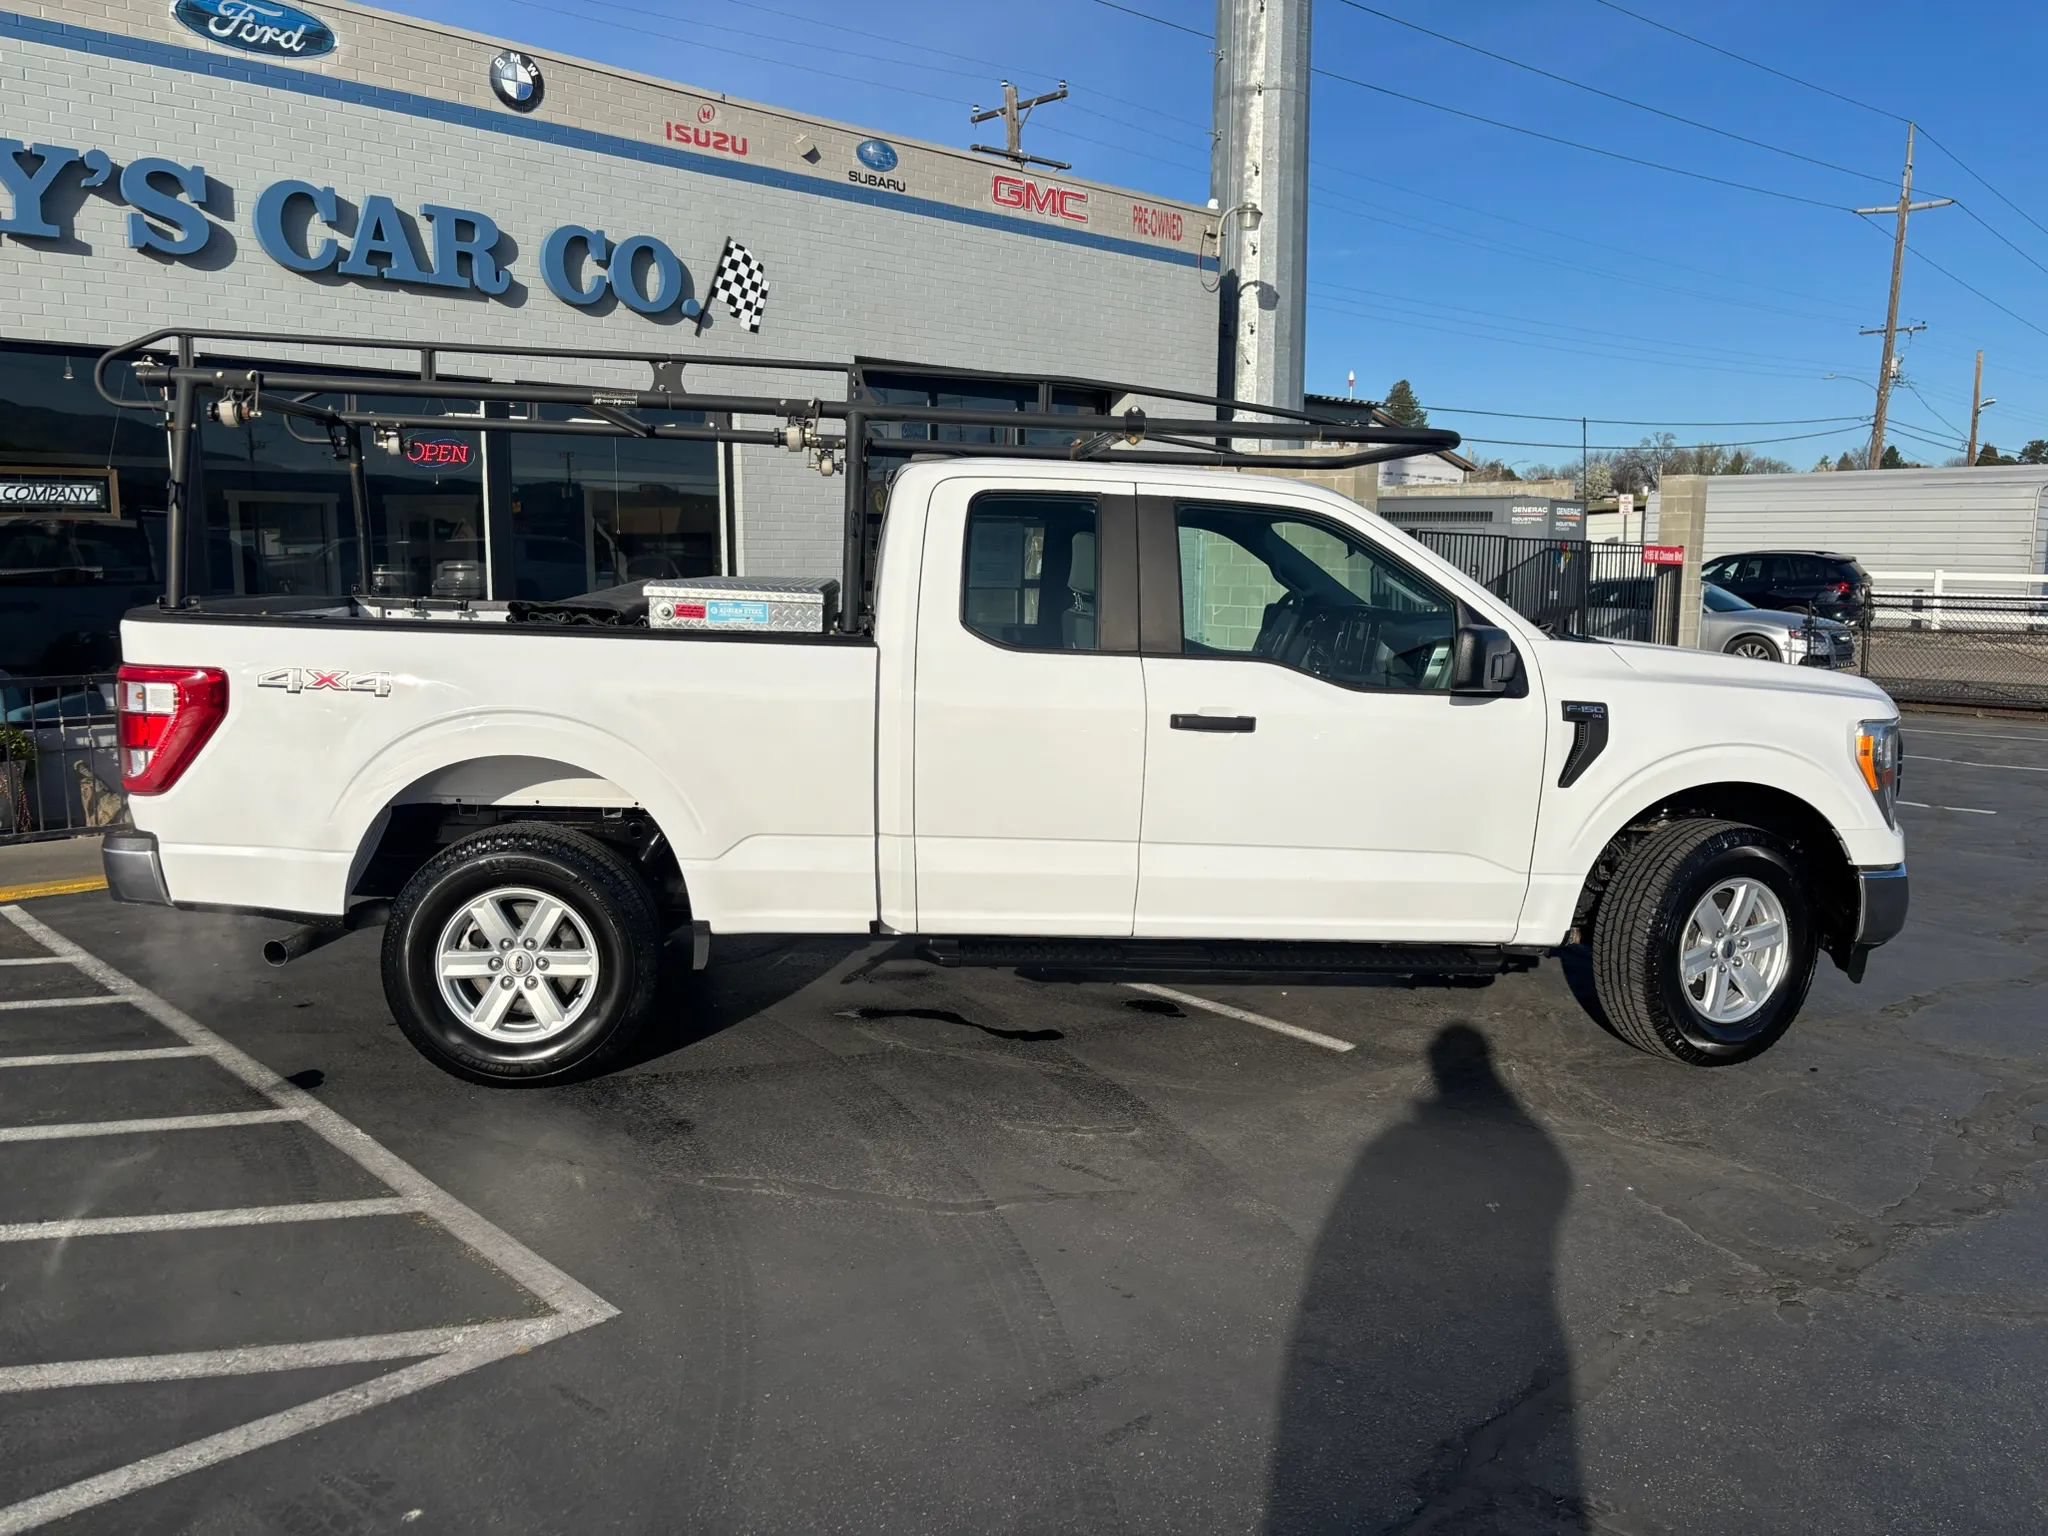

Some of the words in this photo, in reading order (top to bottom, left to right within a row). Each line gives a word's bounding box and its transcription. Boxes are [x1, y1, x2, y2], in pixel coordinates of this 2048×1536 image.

[208, 0, 307, 52] Ford
[494, 52, 539, 77] BMW
[665, 121, 749, 156] ISUZU
[848, 170, 906, 193] SUBARU
[992, 174, 1089, 224] GMC
[1132, 204, 1184, 242] PRE-OWNED
[252, 179, 513, 296] CAR
[540, 224, 702, 318] CO.
[406, 441, 469, 463] OPEN
[3, 485, 95, 502] COMPANY
[1556, 507, 1582, 515] GENERAC
[1566, 704, 1605, 713] F-150
